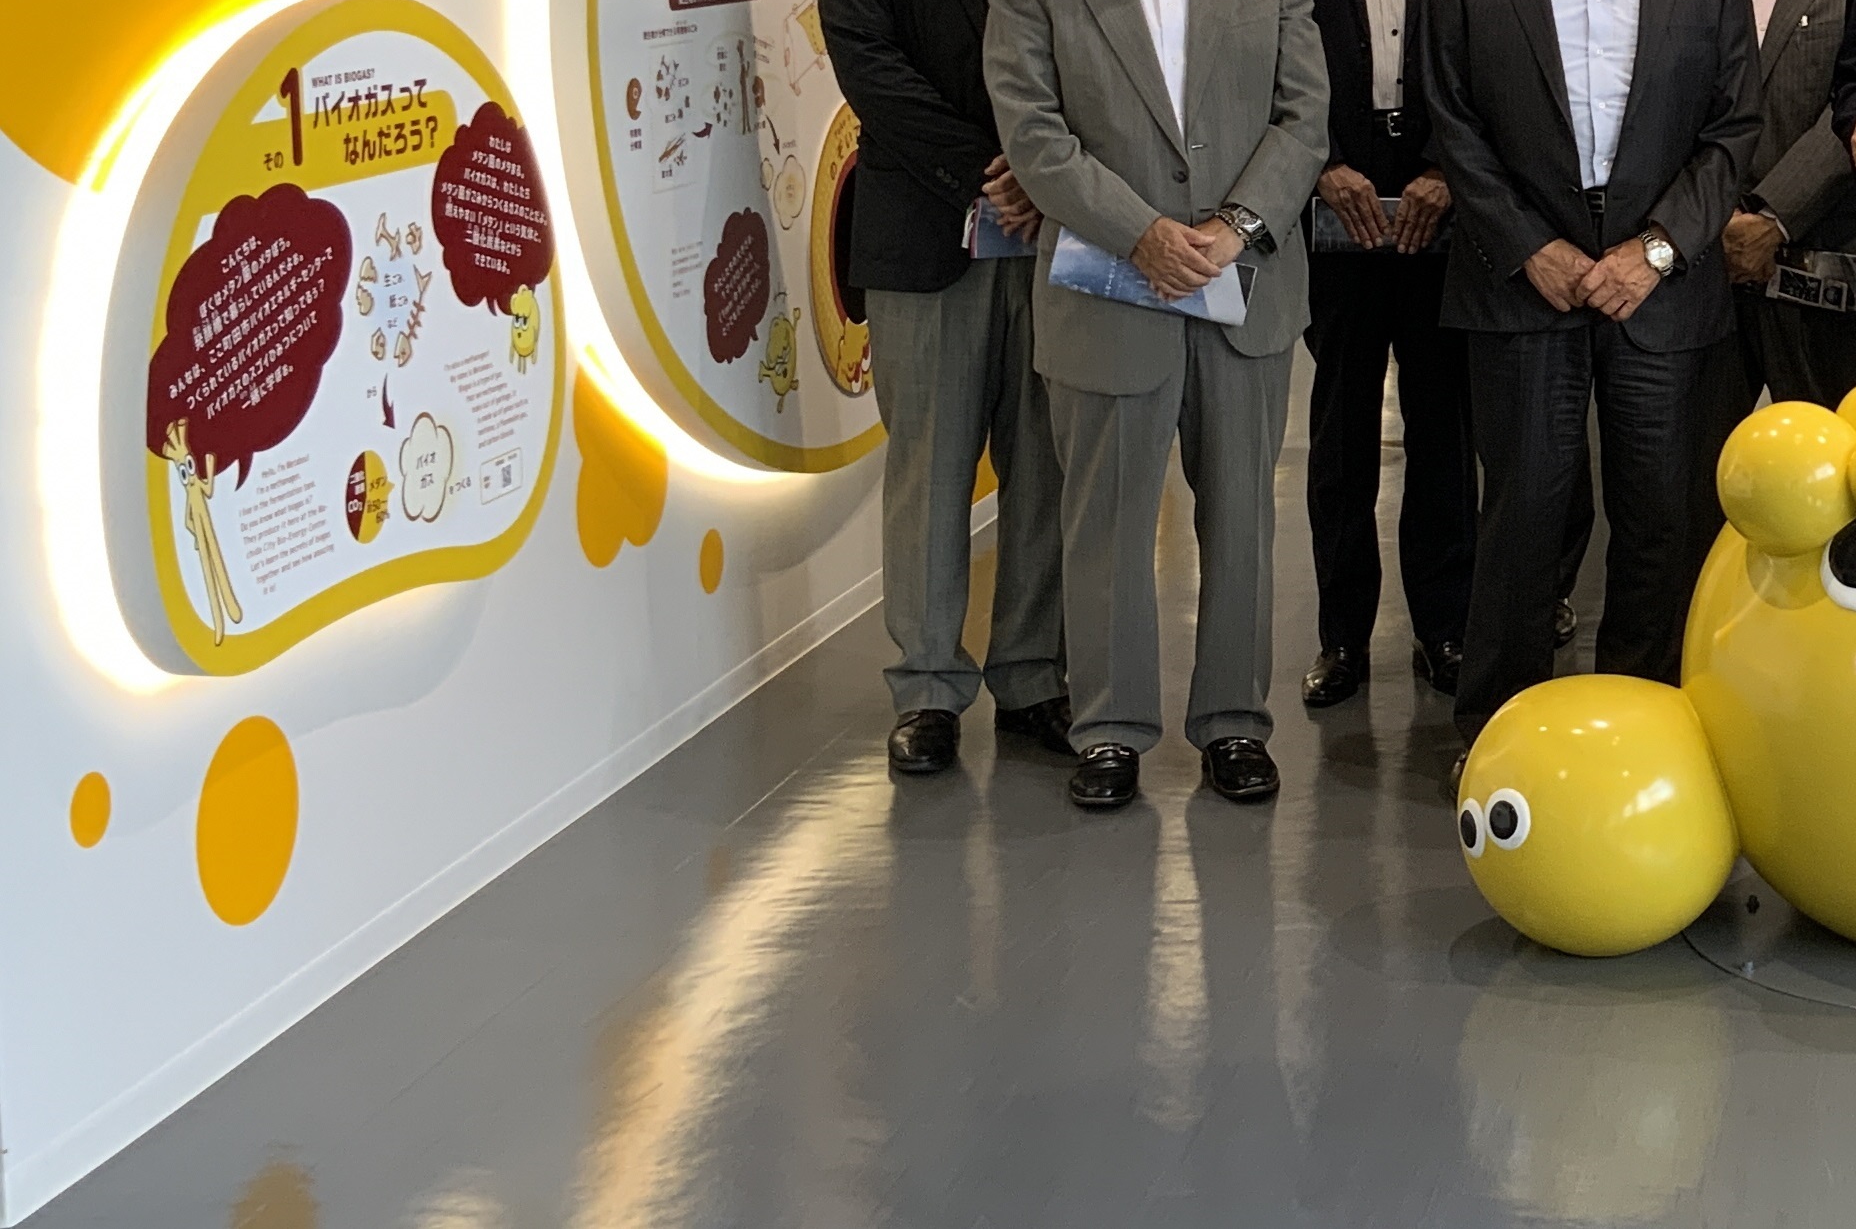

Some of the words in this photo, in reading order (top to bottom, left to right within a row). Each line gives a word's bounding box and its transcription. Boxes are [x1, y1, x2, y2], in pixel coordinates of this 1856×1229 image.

[311, 74, 333, 88] WHAT
[334, 73, 342, 84] IS
[344, 68, 375, 83] BIOGAS?
[263, 151, 284, 171] その
[280, 67, 303, 166] 1
[313, 79, 428, 129] バイオガスって
[343, 115, 438, 166] なんだろう？
[221, 236, 262, 273] こんにちは、
